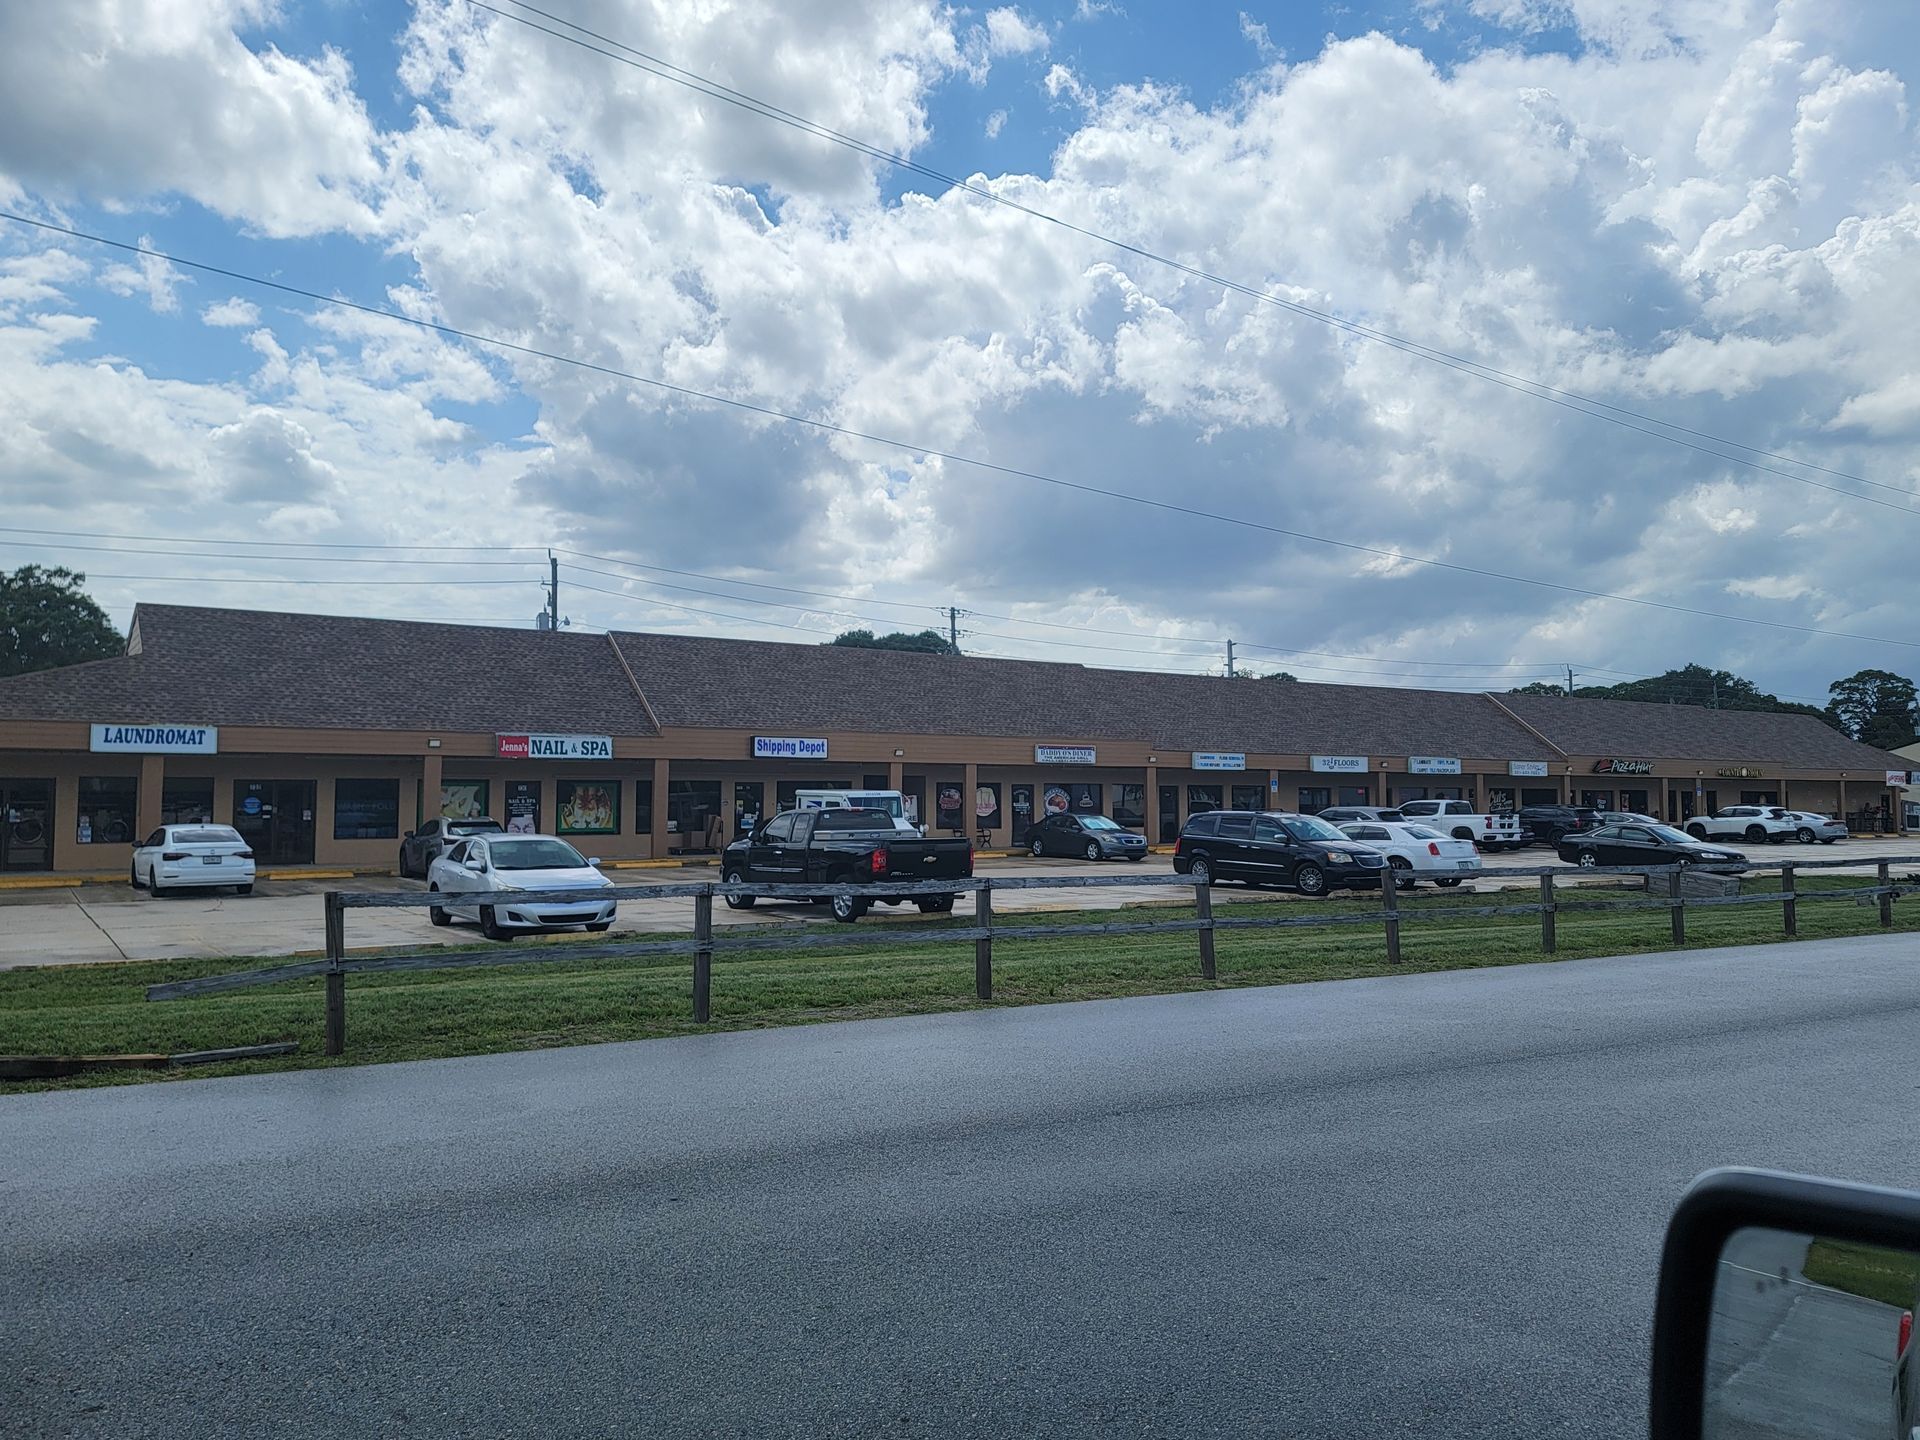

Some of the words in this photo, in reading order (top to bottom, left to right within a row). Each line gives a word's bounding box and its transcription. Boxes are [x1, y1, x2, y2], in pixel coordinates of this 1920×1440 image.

[103, 727, 206, 745] LAUNDROMAT
[500, 740, 528, 752] Jenna's
[531, 740, 568, 755] NAIL
[571, 742, 578, 753] &
[581, 740, 610, 755] SPA
[757, 739, 796, 755] Shipping
[799, 740, 825, 755] Depot
[1334, 759, 1360, 767] FLOORS
[1611, 759, 1636, 773] Pizza
[1635, 760, 1656, 775] Hut
